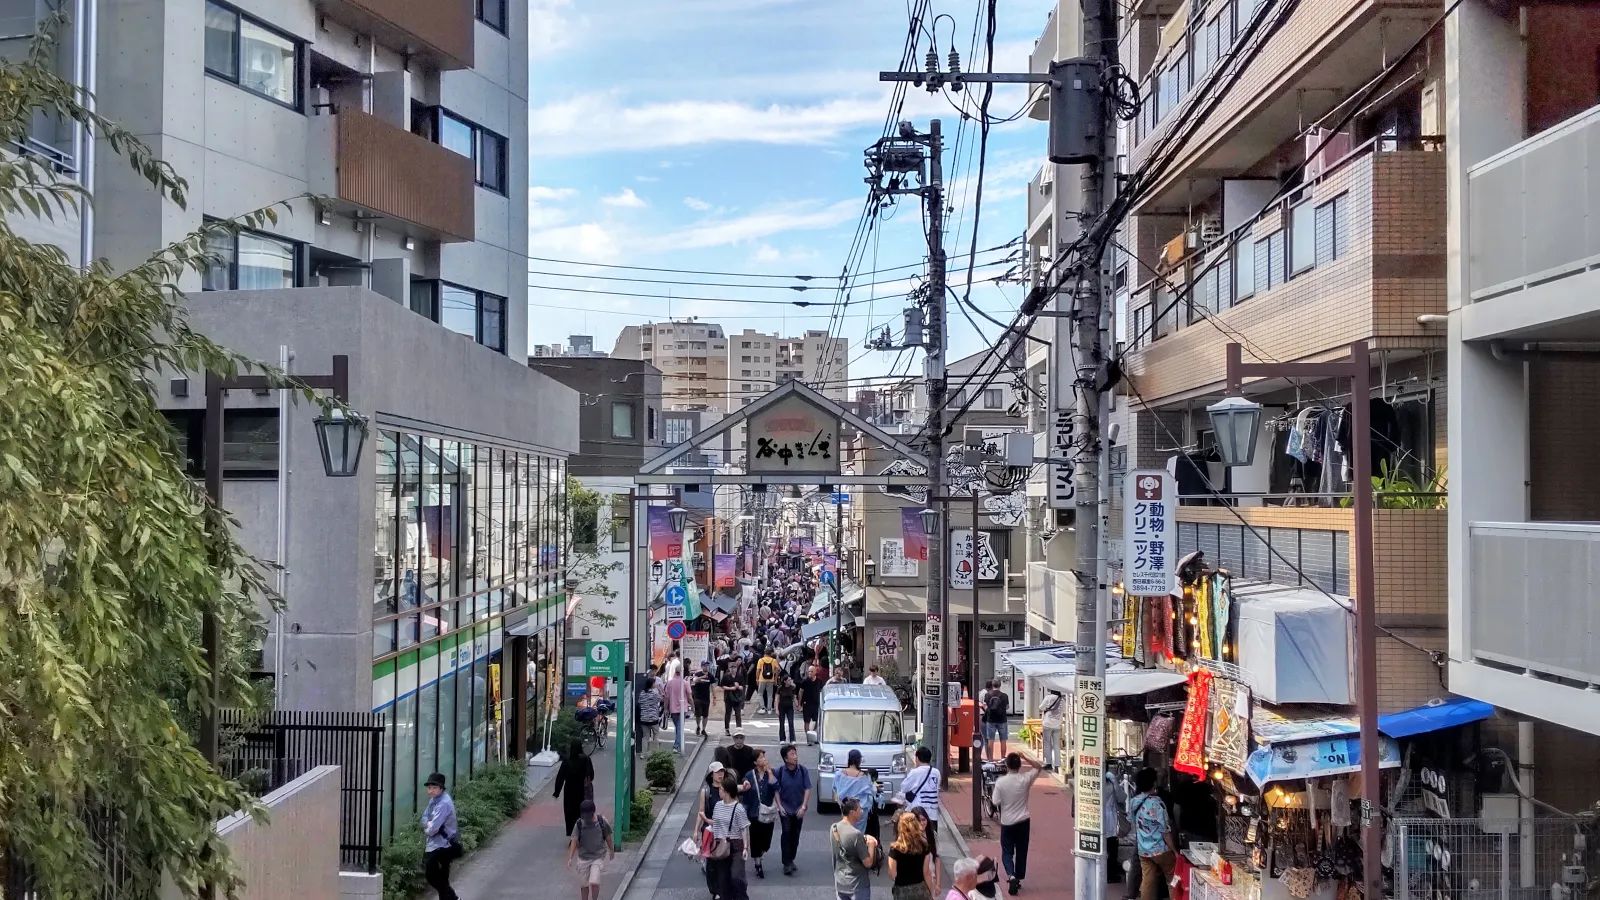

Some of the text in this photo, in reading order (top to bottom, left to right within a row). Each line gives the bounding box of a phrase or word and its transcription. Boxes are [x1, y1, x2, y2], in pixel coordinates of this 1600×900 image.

[755, 428, 832, 466] 谷中ぎんざ
[1134, 502, 1148, 570] クリニック
[1149, 502, 1165, 571] 動物・野澤
[876, 637, 897, 656] 飴
[1323, 754, 1346, 765] No.
